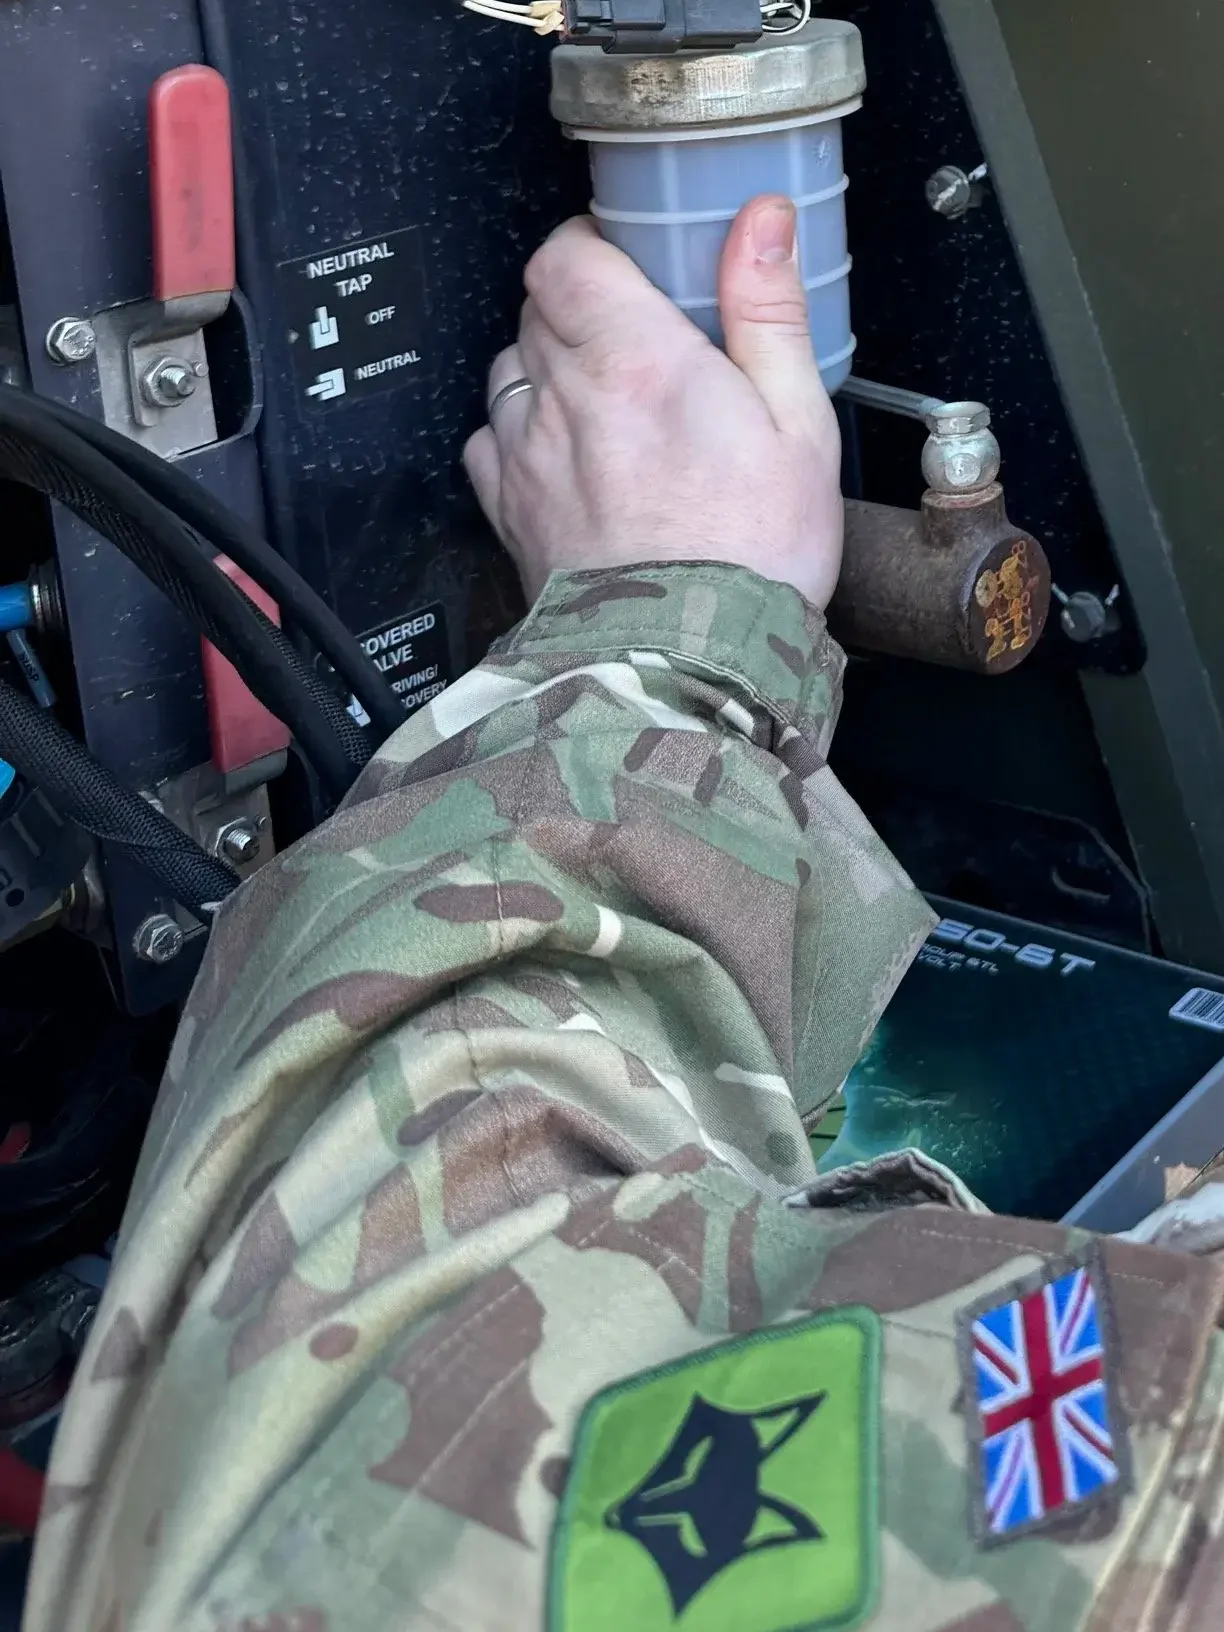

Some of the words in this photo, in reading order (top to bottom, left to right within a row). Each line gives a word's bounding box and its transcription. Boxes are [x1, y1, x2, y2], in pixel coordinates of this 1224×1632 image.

[307, 242, 395, 279] NEUTRAL
[333, 273, 373, 298] TAP
[366, 305, 396, 326] OFF
[355, 350, 422, 380] NEUTRAL
[360, 612, 436, 656] OVERED
[391, 663, 439, 694] RIVING/
[401, 679, 448, 709] OVERY
